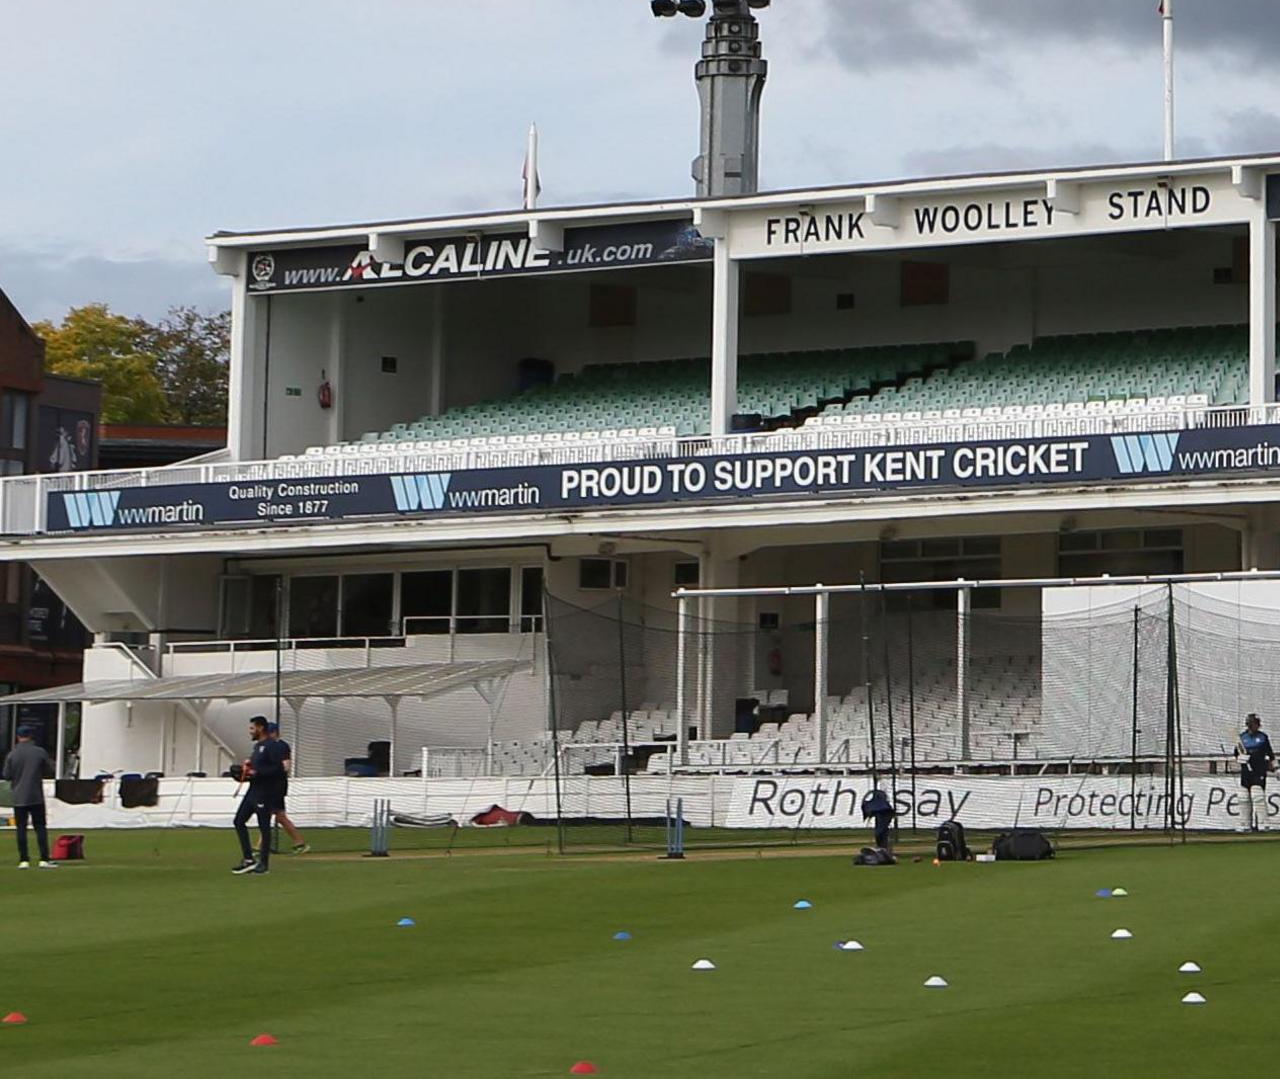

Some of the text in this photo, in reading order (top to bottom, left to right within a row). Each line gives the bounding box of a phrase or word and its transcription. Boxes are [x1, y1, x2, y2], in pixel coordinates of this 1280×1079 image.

[766, 186, 1211, 245] FRANK WOOLLEY STAND
[1178, 442, 1280, 469] wwmartin
[561, 442, 1089, 500] PROUD TO SUPPORT KENT CRICKET
[229, 481, 359, 501] Quality Construction
[449, 483, 540, 507] wwmartin
[117, 499, 204, 525] wwmartin
[257, 501, 329, 516] Since 1877
[749, 779, 972, 822] Rothsay
[1034, 786, 1195, 825] Protecting
